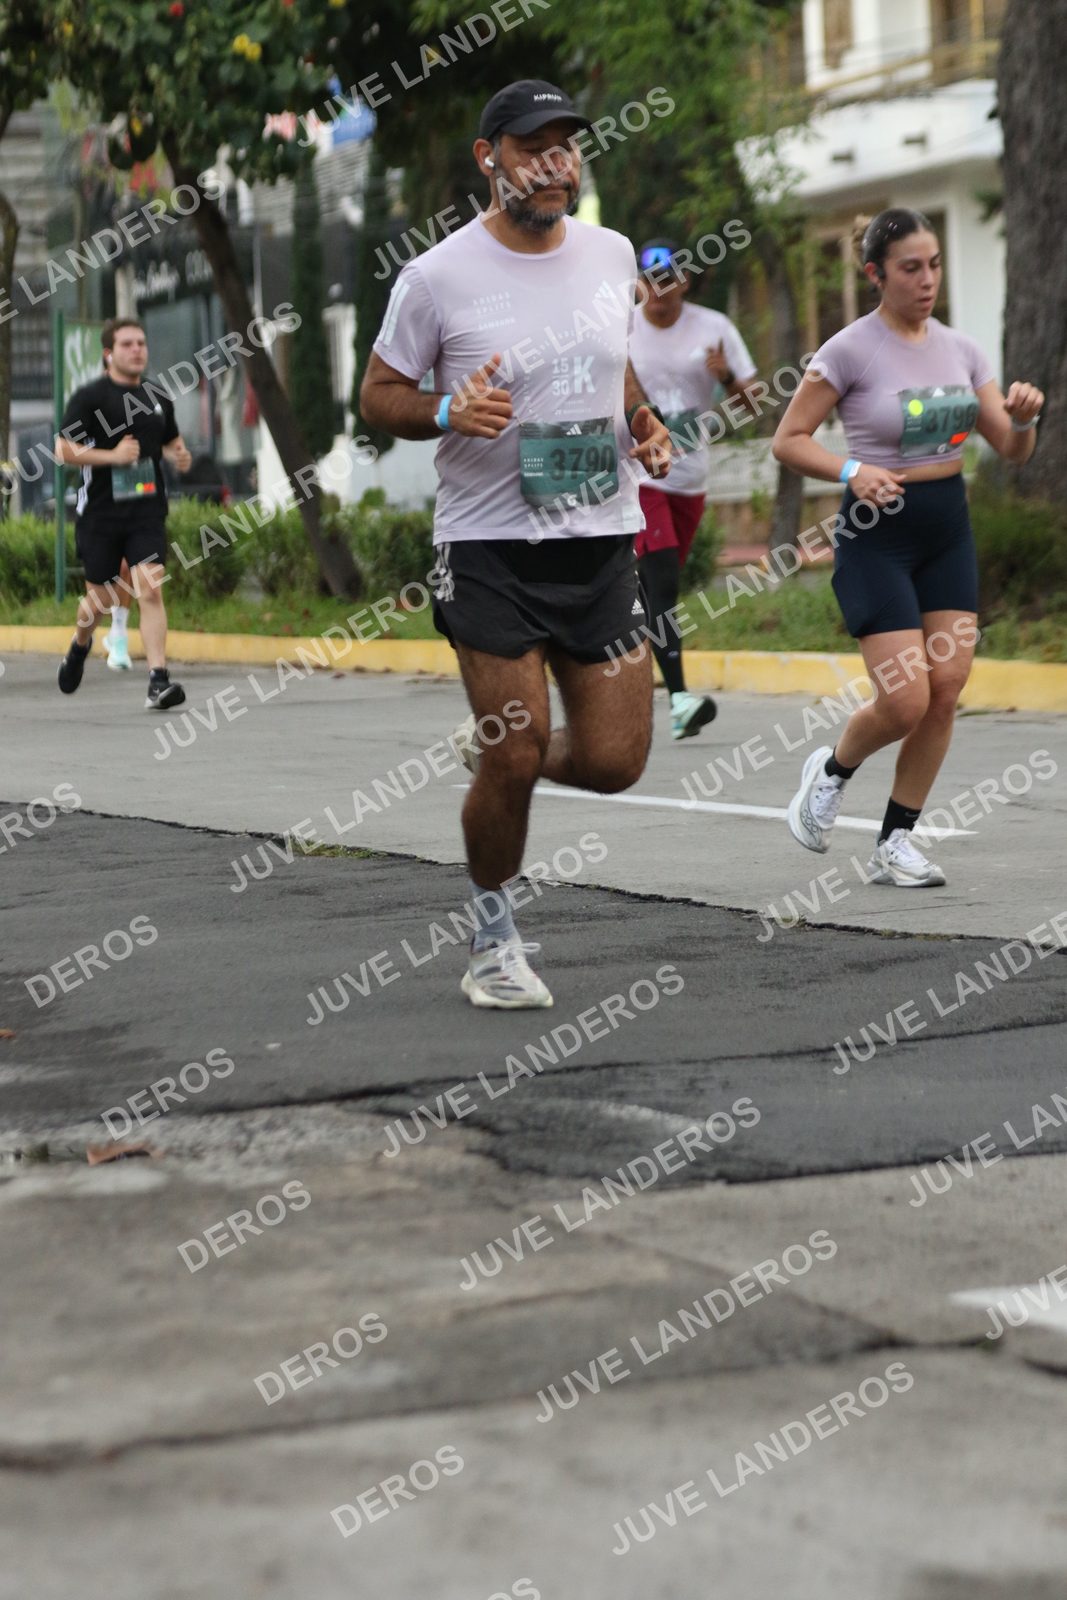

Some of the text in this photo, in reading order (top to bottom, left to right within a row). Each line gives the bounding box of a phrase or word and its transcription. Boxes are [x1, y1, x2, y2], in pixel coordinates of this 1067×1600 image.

[551, 357, 569, 374] 15
[573, 355, 597, 394] K
[551, 379, 569, 396] 30
[550, 445, 615, 481] 3790
